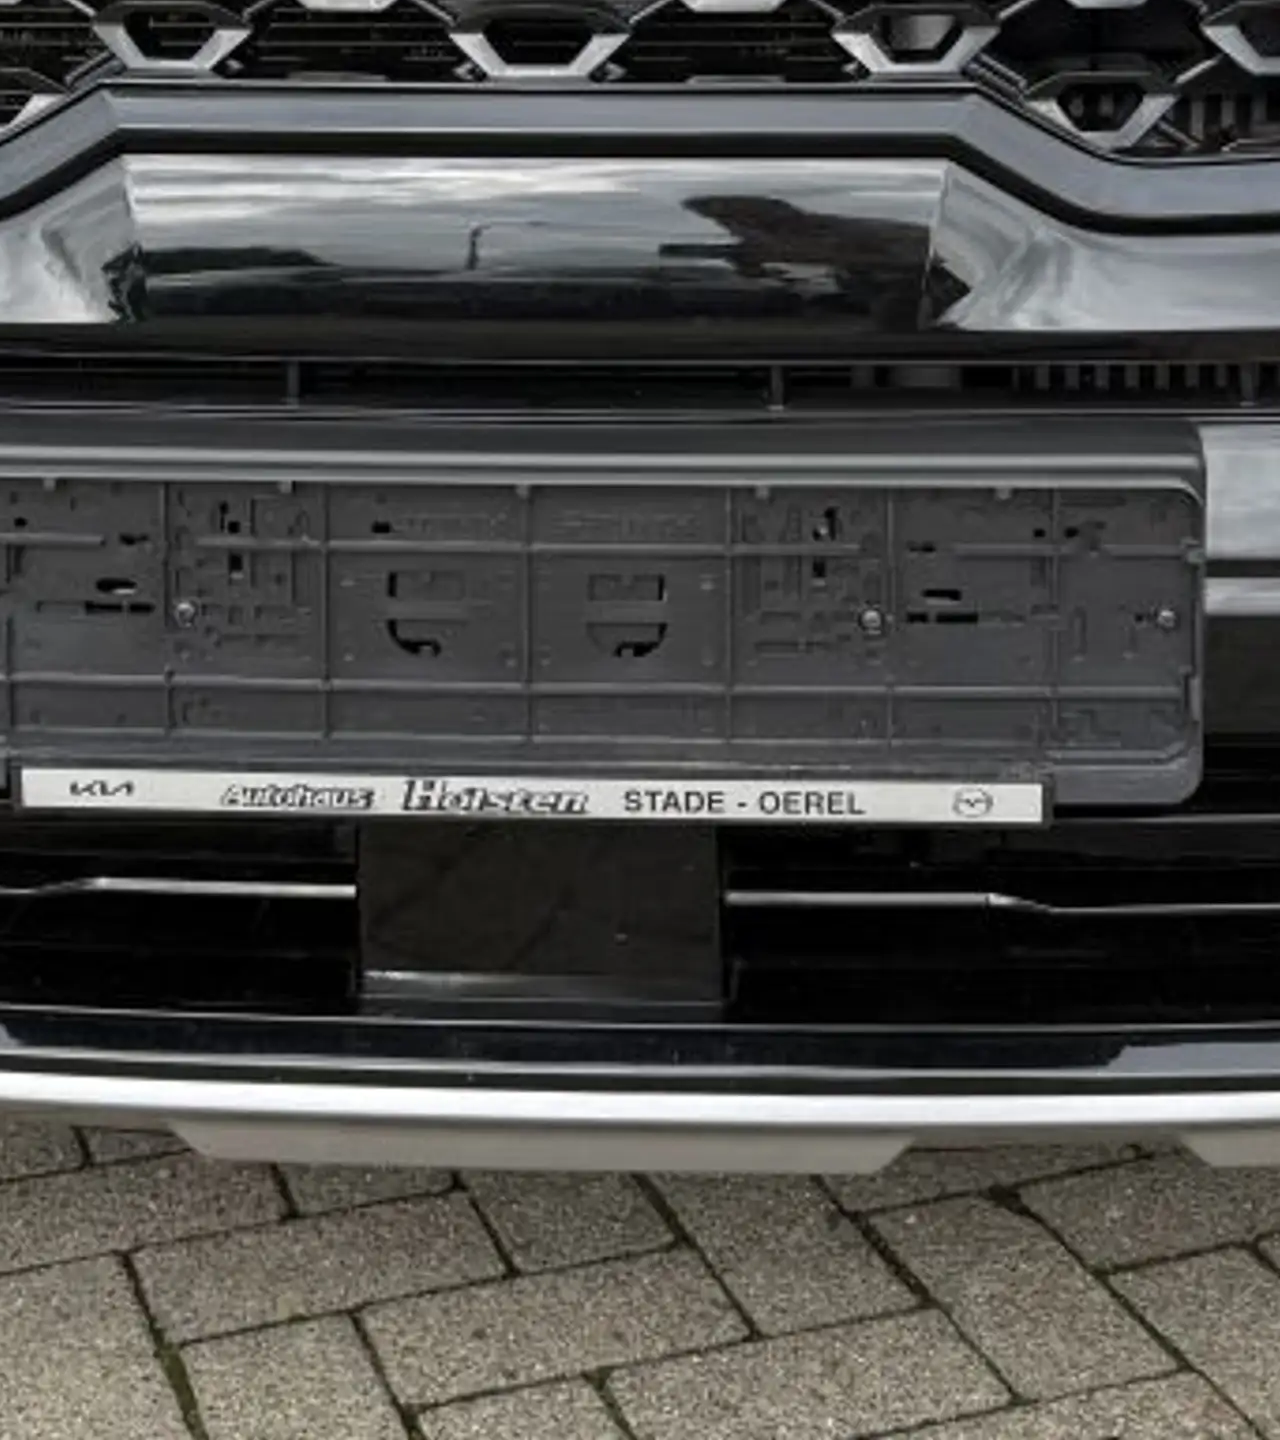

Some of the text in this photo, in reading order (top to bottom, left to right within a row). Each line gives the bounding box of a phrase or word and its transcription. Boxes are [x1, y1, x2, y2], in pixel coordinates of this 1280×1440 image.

[222, 784, 375, 810] Autohaus
[401, 777, 591, 816] Holsten
[624, 791, 724, 816] STADE
[758, 791, 866, 817] OEREL
